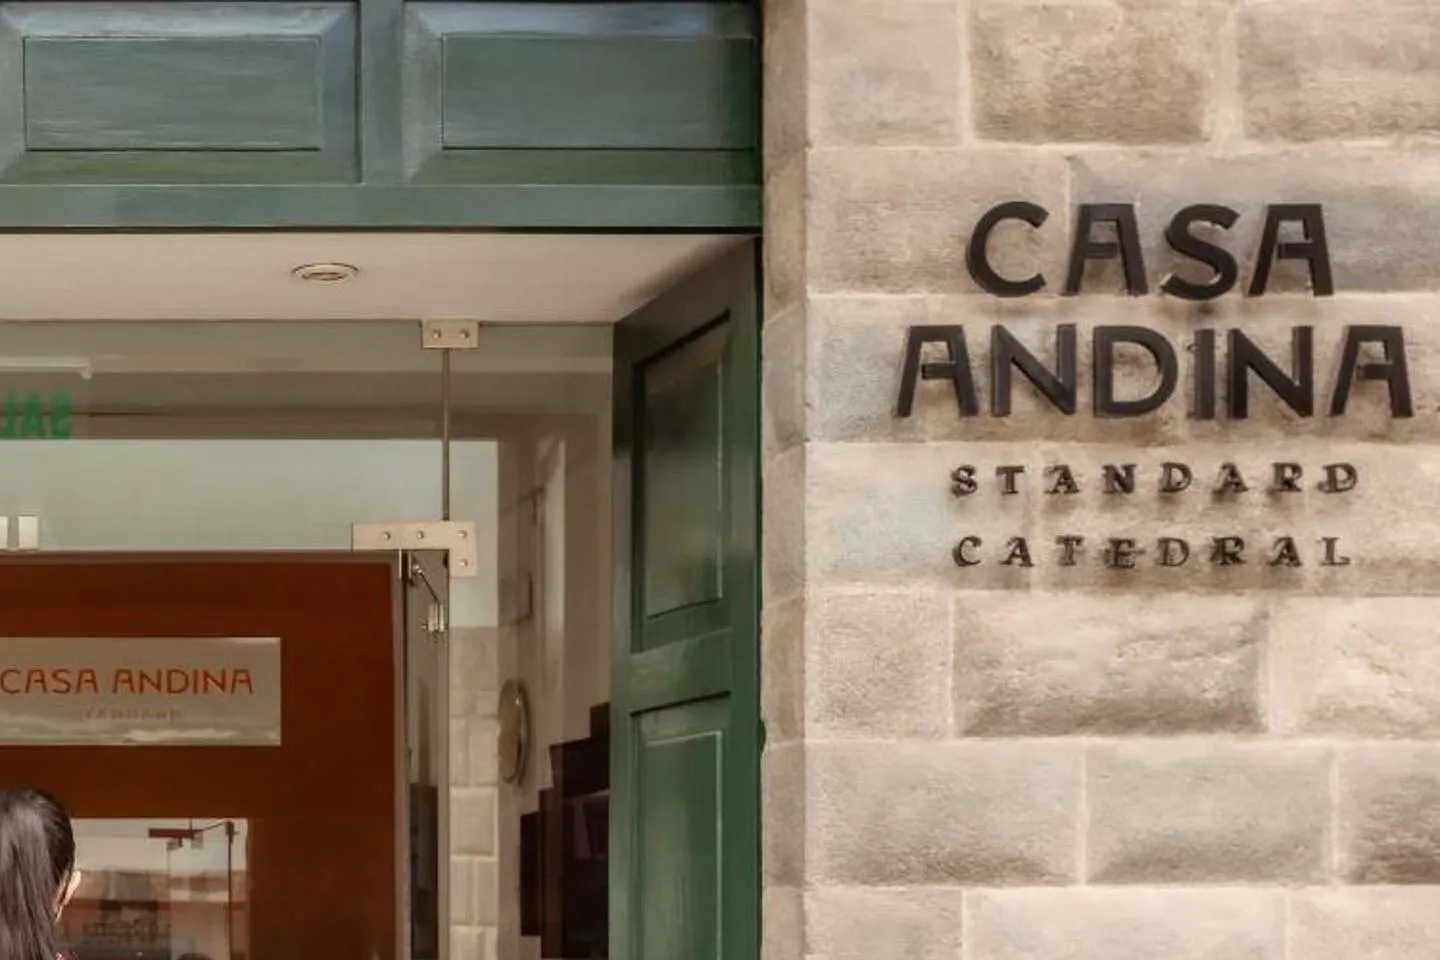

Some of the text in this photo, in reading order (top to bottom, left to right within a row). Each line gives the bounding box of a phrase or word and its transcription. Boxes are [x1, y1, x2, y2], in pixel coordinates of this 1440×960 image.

[965, 200, 1334, 300] CASA
[892, 323, 1415, 420] ANDINA
[950, 462, 1358, 498] STANDARD
[952, 535, 1351, 569] CATEDRAL
[111, 668, 253, 695] ANDINA
